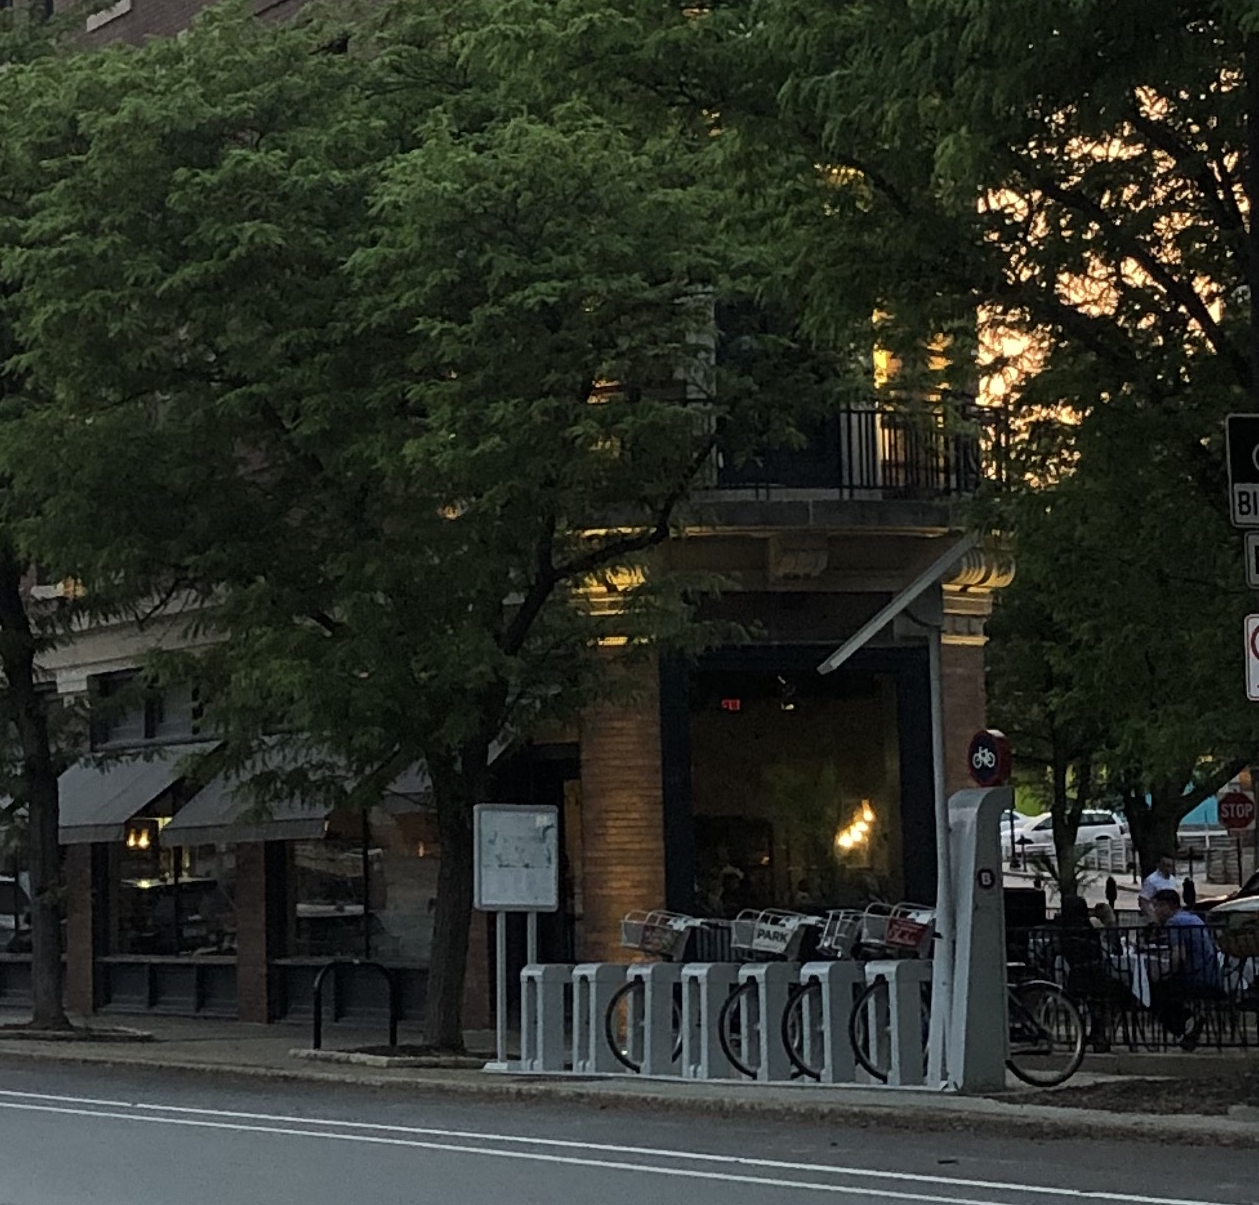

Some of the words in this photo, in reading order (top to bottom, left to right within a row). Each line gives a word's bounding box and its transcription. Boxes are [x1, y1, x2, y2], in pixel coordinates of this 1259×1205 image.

[1238, 491, 1258, 516] BI
[1220, 803, 1253, 818] STOP
[757, 928, 788, 943] PARK
